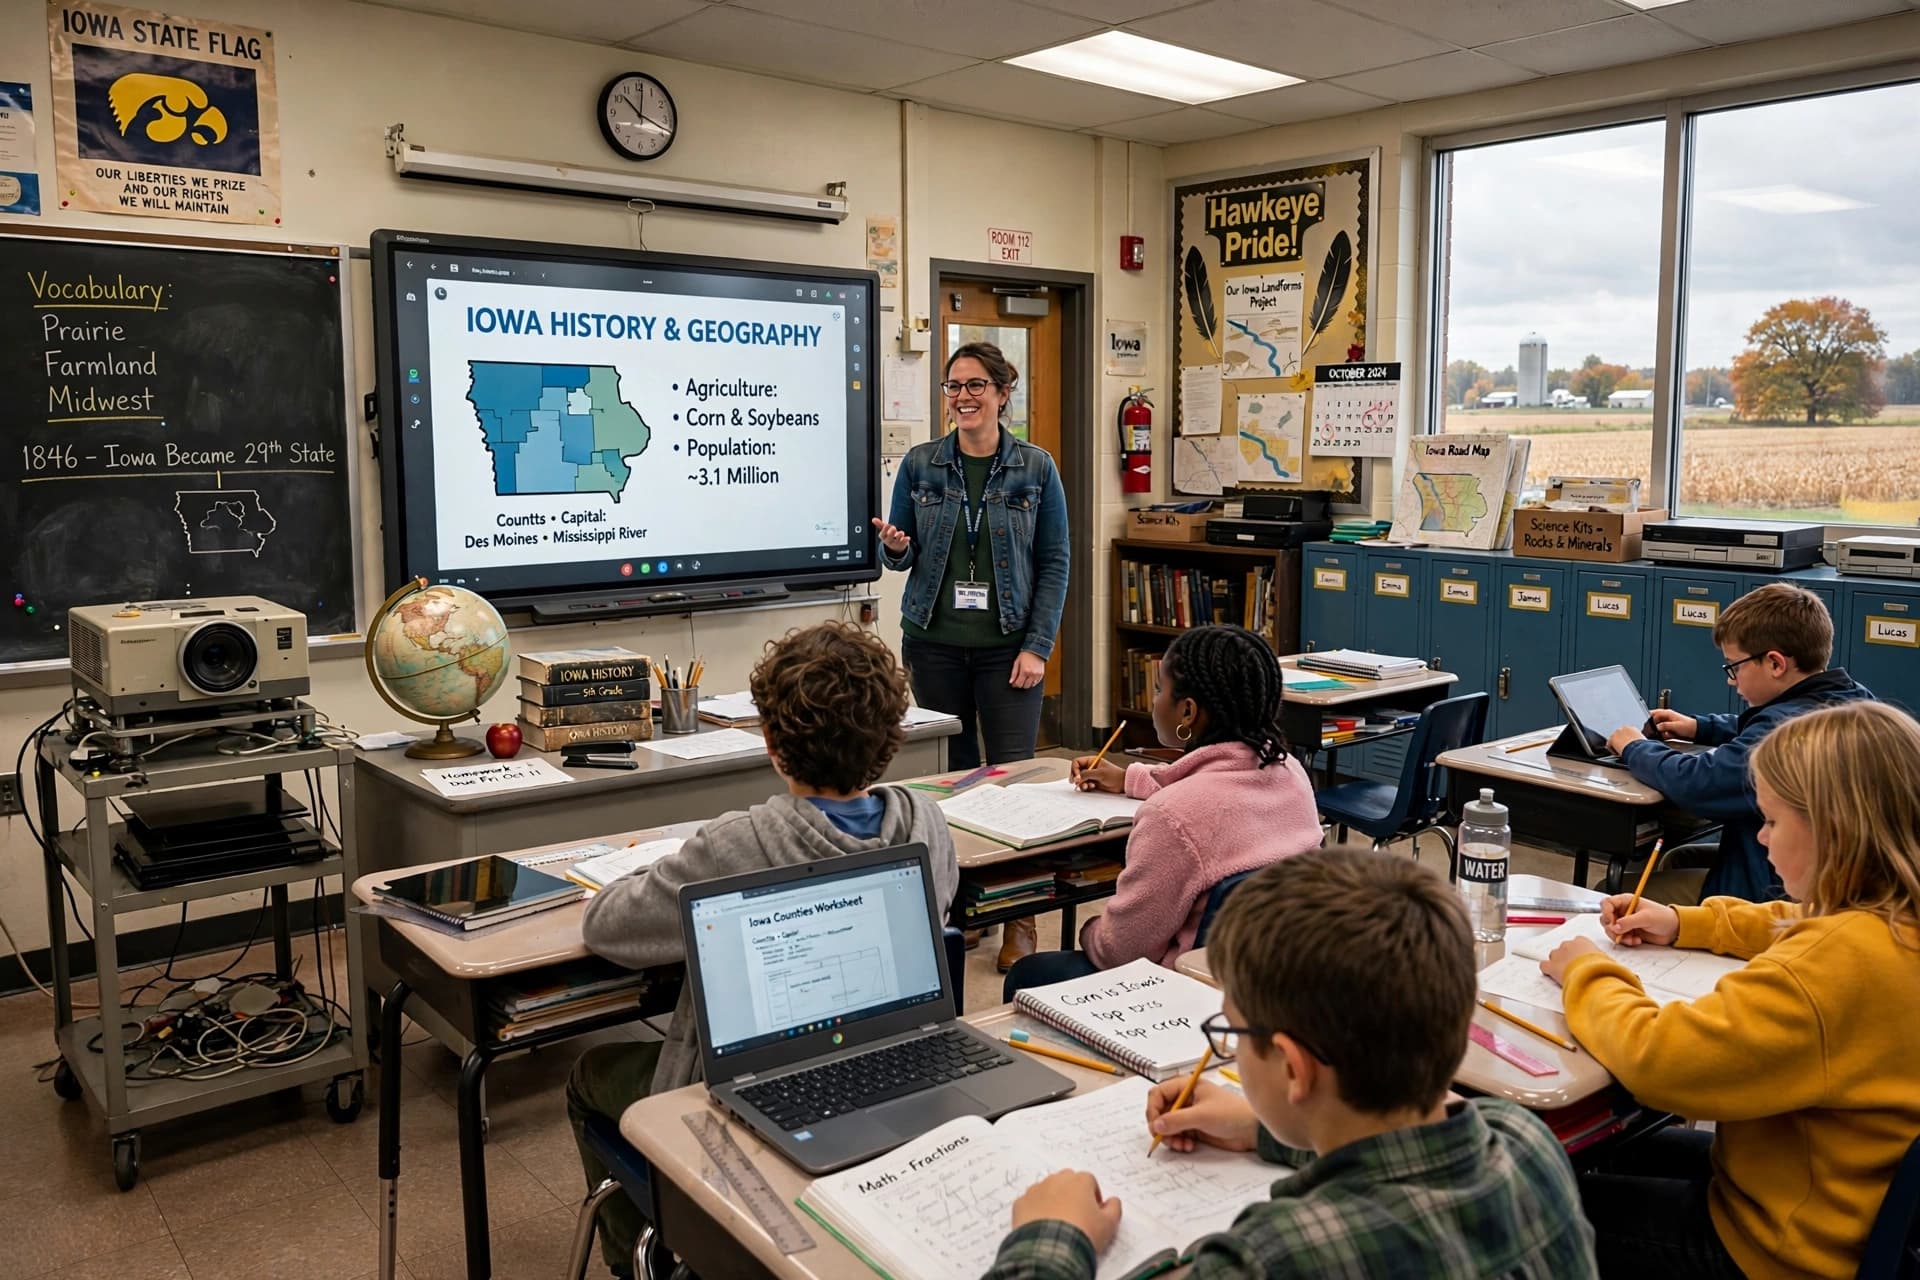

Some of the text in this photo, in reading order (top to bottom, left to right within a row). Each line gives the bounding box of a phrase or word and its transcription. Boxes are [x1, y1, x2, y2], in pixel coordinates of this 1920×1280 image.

[63, 9, 261, 60] IOWA STATE FLAG
[95, 167, 246, 191] OUR LIBERTIES WE PRIZE
[123, 183, 224, 202] AND OUR RIGHTS
[119, 195, 229, 215] WE WILL MAINTAIN
[1209, 191, 1320, 229] Hawkeye
[992, 231, 1030, 248] ROOM 112
[1225, 224, 1297, 262] Pride!
[1001, 247, 1021, 261] EXIT
[27, 270, 173, 312] Vocabulary:
[1226, 279, 1302, 296] Our Iowa Landforms
[1250, 296, 1277, 310] Project
[41, 313, 127, 343] Prairie
[466, 306, 822, 347] IOWA HISTORY & GEOGRAPHY
[1111, 333, 1141, 351] Iowa
[45, 350, 158, 377] Farmland
[1367, 367, 1387, 378] 2024
[48, 385, 155, 413] Midwest
[685, 377, 777, 402] Agriculture:
[686, 407, 820, 431] Corn & Soybeans
[22, 443, 79, 470] 1846
[103, 443, 158, 468] Iowa
[166, 442, 236, 466] Became
[245, 441, 283, 465] 29th
[290, 442, 336, 464] State
[687, 437, 776, 461] Population:
[1425, 444, 1490, 458] Iowa Road Map
[687, 465, 779, 486] ~3.1 Million
[561, 508, 606, 527] Capital:
[1531, 518, 1569, 535] Science
[1573, 521, 1593, 535] Kits
[465, 526, 647, 549] Des Moines Mississippi River
[1524, 536, 1612, 553] Rocks & Minerals
[1681, 606, 1708, 620] Lucas
[1877, 623, 1908, 638] Lucas
[560, 665, 634, 682] IOWA HISTORY
[1464, 858, 1505, 879] WATER
[749, 895, 863, 928] Iowa Counties Worksheet
[1060, 993, 1103, 1006] Corn
[1100, 987, 1119, 997] is
[1090, 1009, 1126, 1023] top
[1115, 1017, 1192, 1039] top crop
[858, 1172, 898, 1194] Math
[908, 1135, 970, 1172] Fractions
